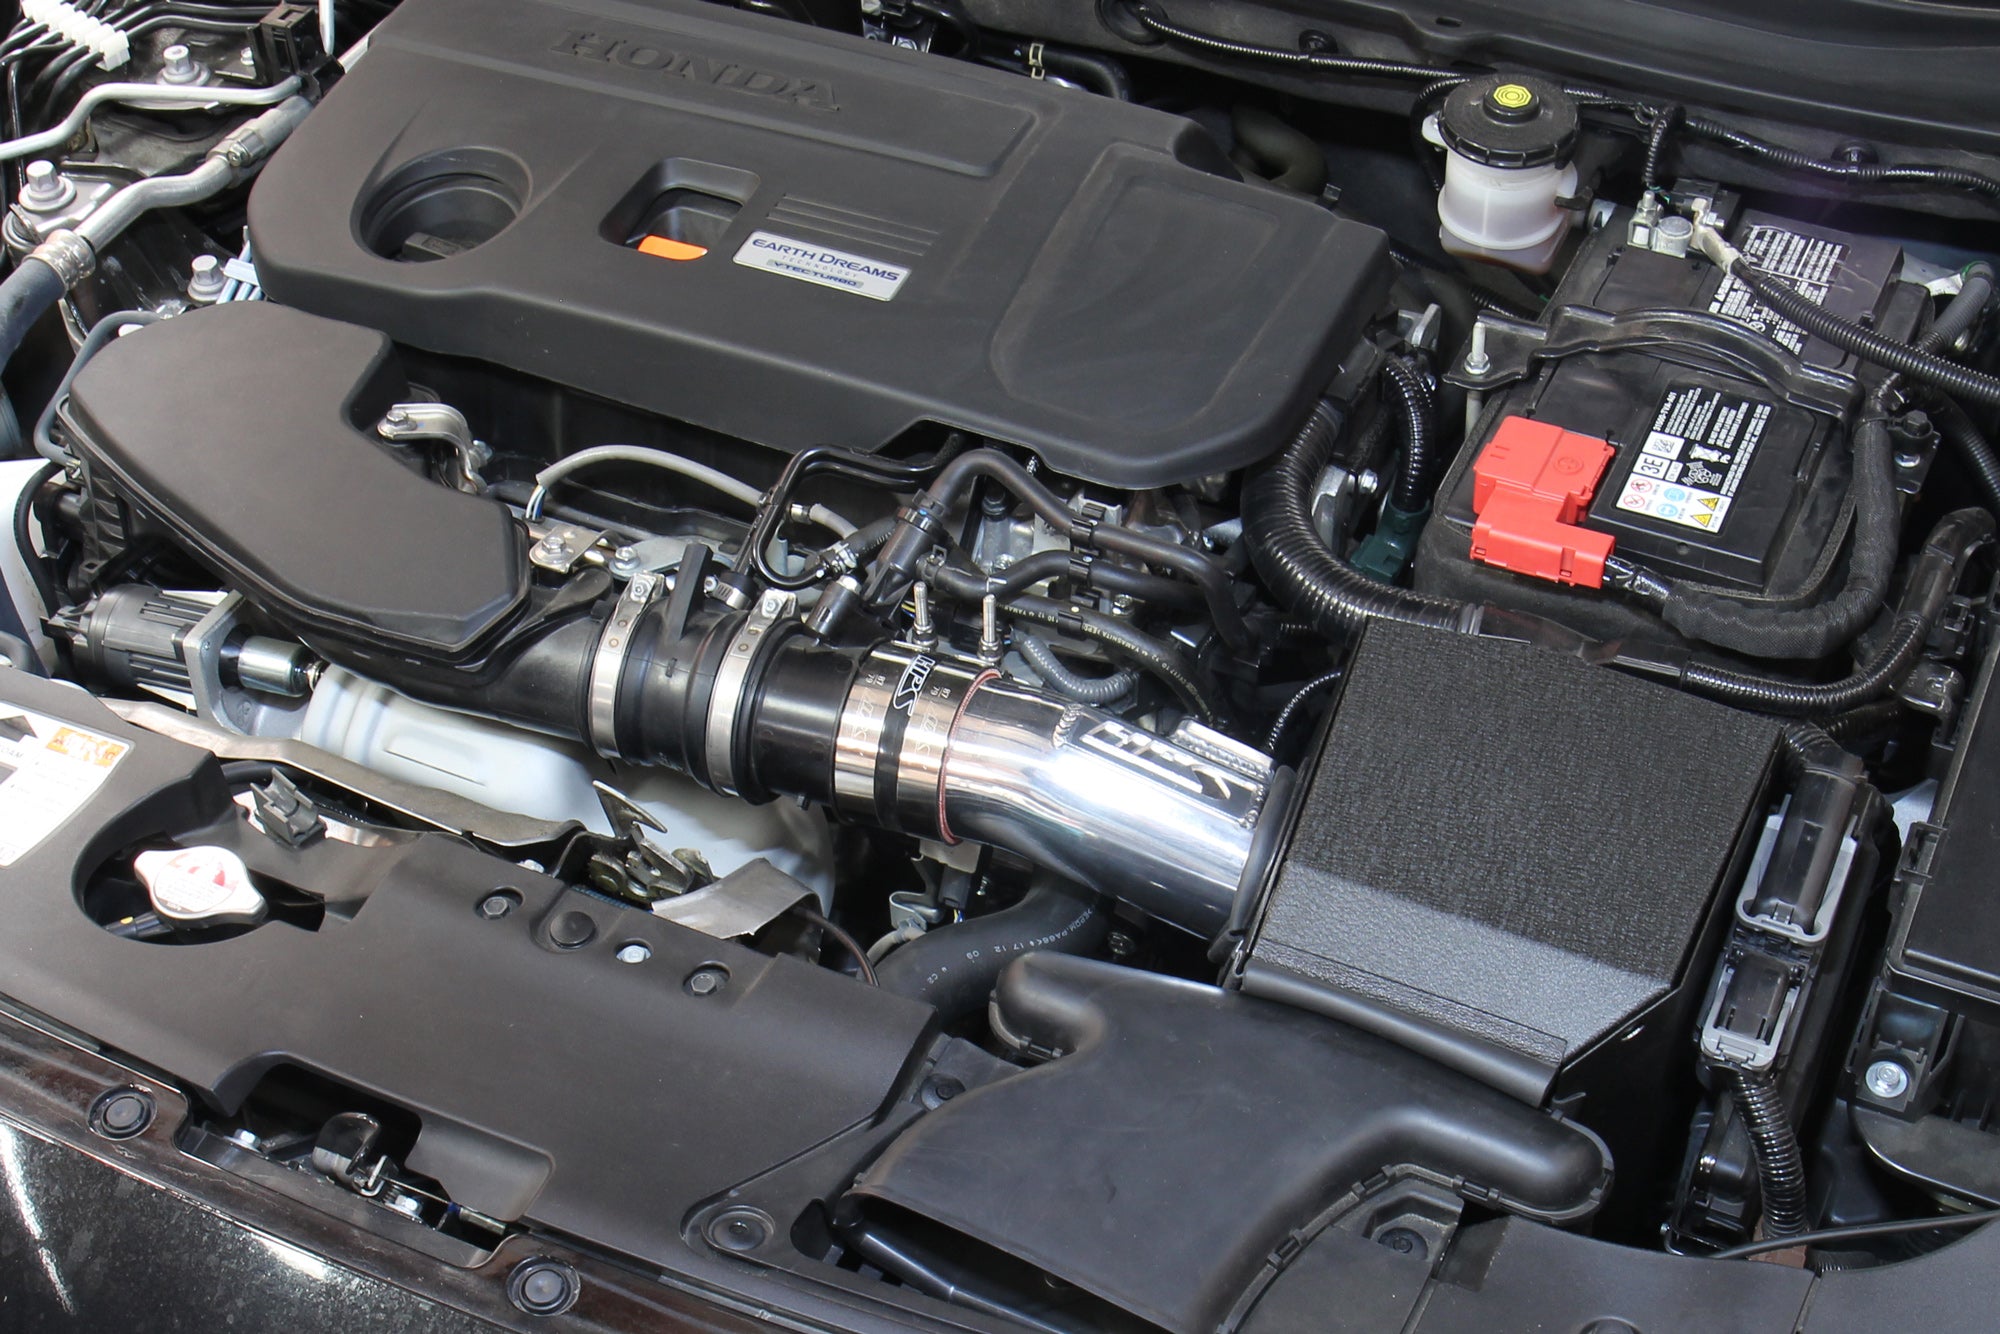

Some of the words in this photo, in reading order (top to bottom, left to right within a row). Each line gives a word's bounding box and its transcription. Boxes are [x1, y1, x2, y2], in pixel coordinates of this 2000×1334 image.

[551, 29, 839, 112] HONDA
[752, 238, 816, 260] EARTH
[819, 252, 900, 282] DREAMS
[782, 255, 858, 278] TECHNOLOGY
[1641, 457, 1664, 474] 3E
[1102, 631, 1140, 653] YAMASHITA
[893, 654, 936, 717] HPS
